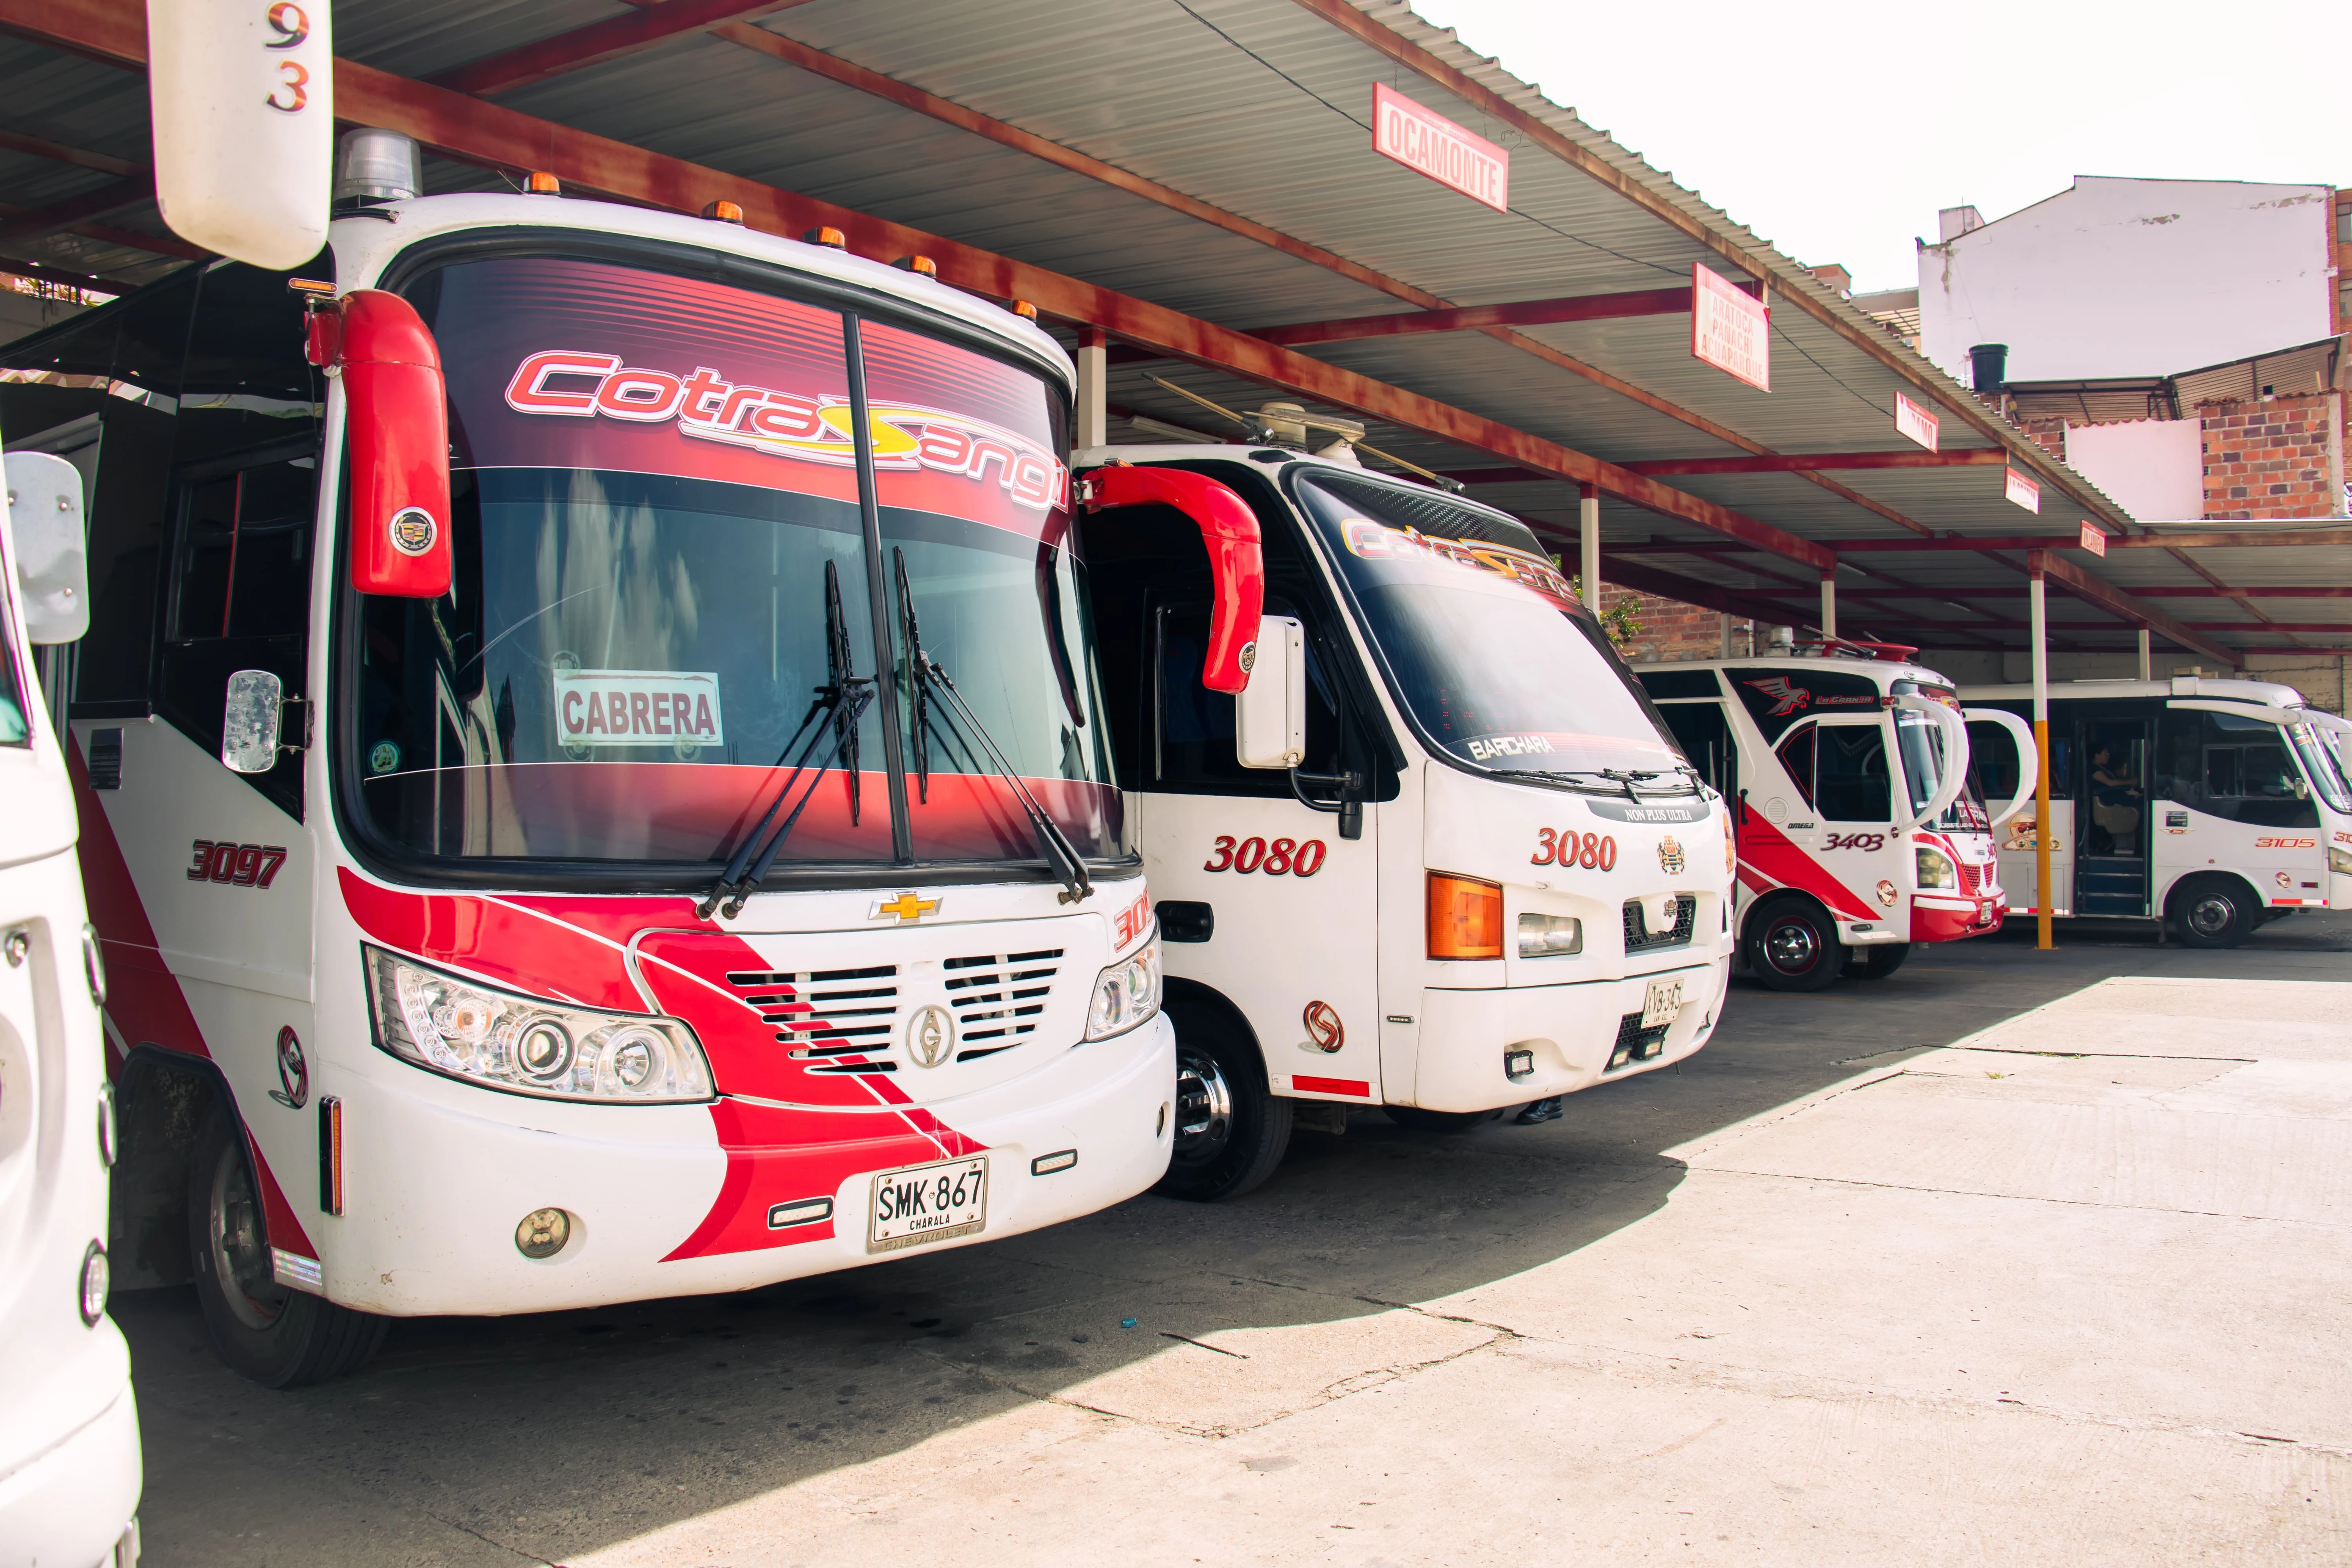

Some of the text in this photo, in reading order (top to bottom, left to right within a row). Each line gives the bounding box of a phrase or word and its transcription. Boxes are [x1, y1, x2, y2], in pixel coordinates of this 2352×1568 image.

[1389, 109, 1497, 203] OCAMONTE
[1713, 296, 1753, 336] ARATOCA
[1713, 318, 1752, 356] PANACHI
[1701, 334, 1763, 381] ACUAPARQUE
[563, 690, 716, 735] CABRERA
[1467, 735, 1556, 761] BARICHARA
[1625, 809, 1693, 821] NON PLUS ULTRA
[1203, 835, 1327, 878] 3080
[1530, 828, 1617, 872] 3080
[1820, 833, 1885, 851] 3403
[2255, 837, 2316, 848] 3105
[187, 839, 287, 889] 3097
[883, 1225, 971, 1251] CHEVROLET
[910, 1214, 950, 1230] CHARALA
